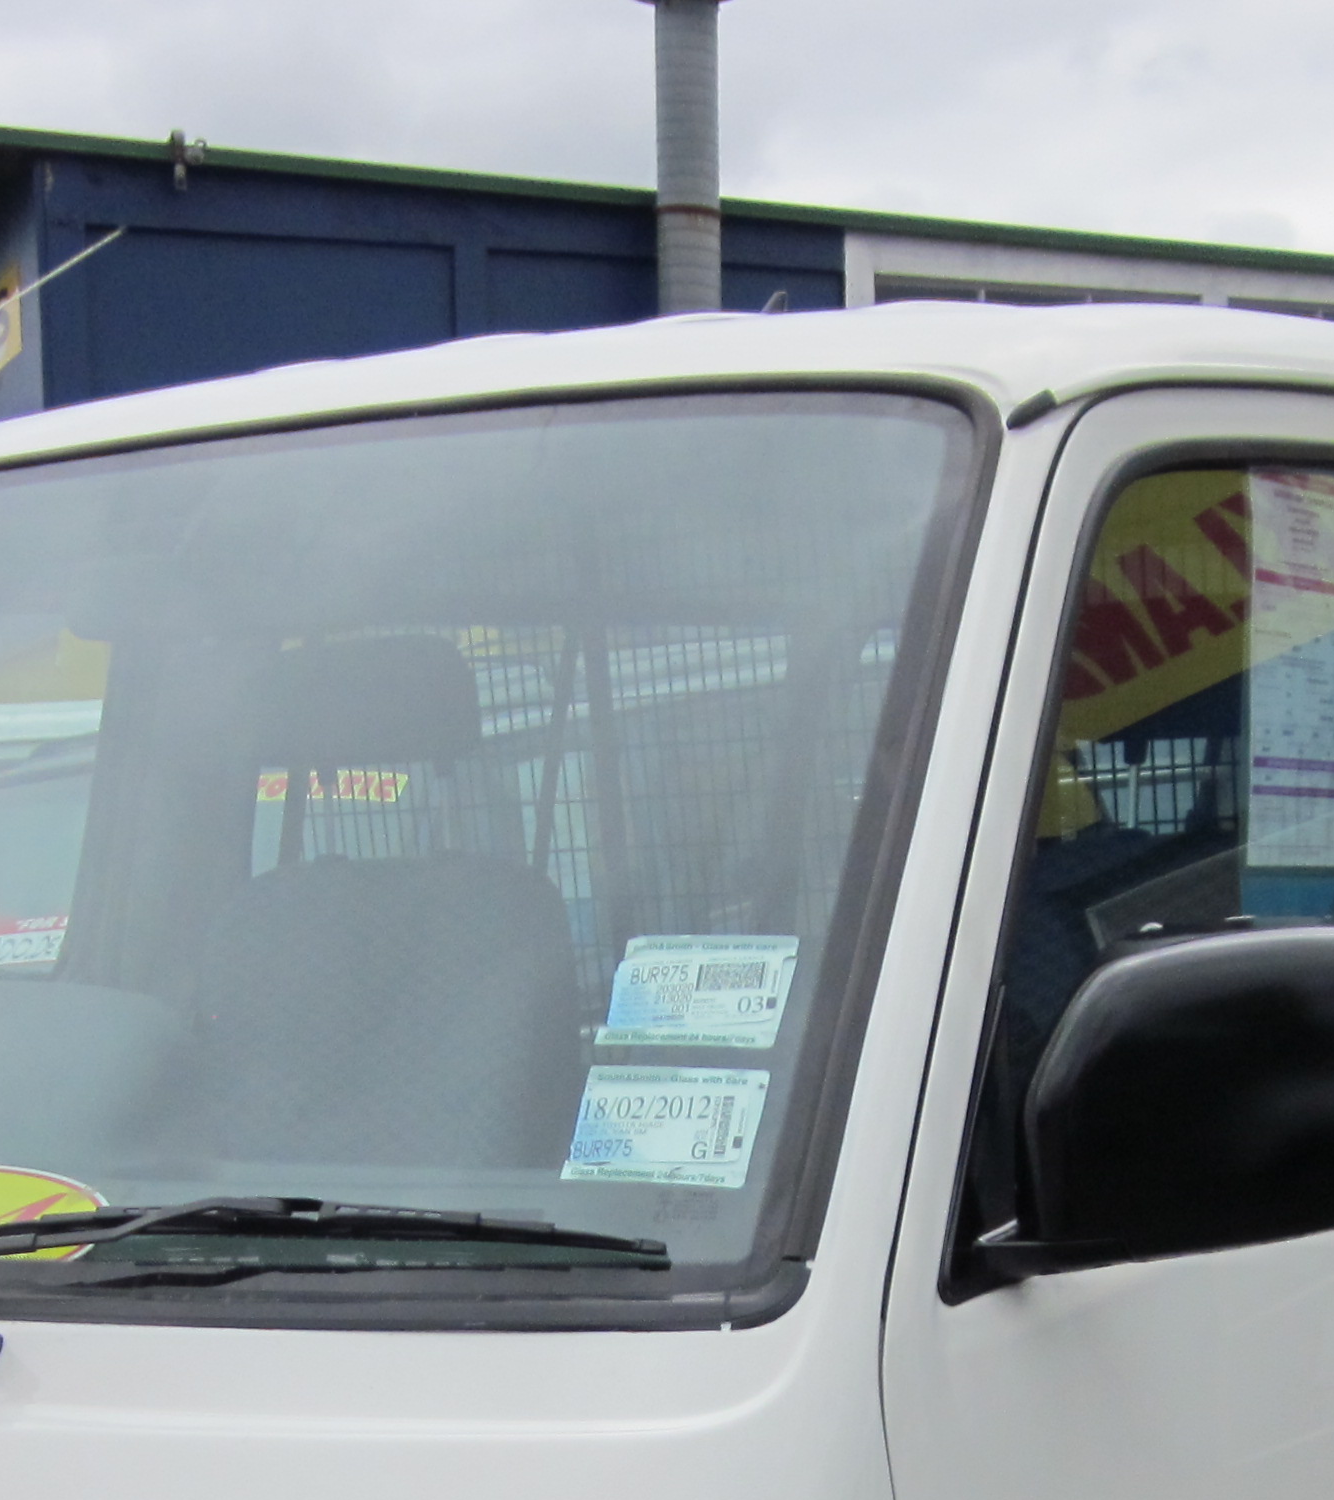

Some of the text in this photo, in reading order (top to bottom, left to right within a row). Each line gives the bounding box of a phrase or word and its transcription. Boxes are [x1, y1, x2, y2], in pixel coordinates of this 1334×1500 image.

[630, 964, 689, 985] BUR975
[737, 996, 765, 1014] 03
[582, 1095, 712, 1121] 18/02/2012
[572, 1138, 709, 1160] BUR975 G
